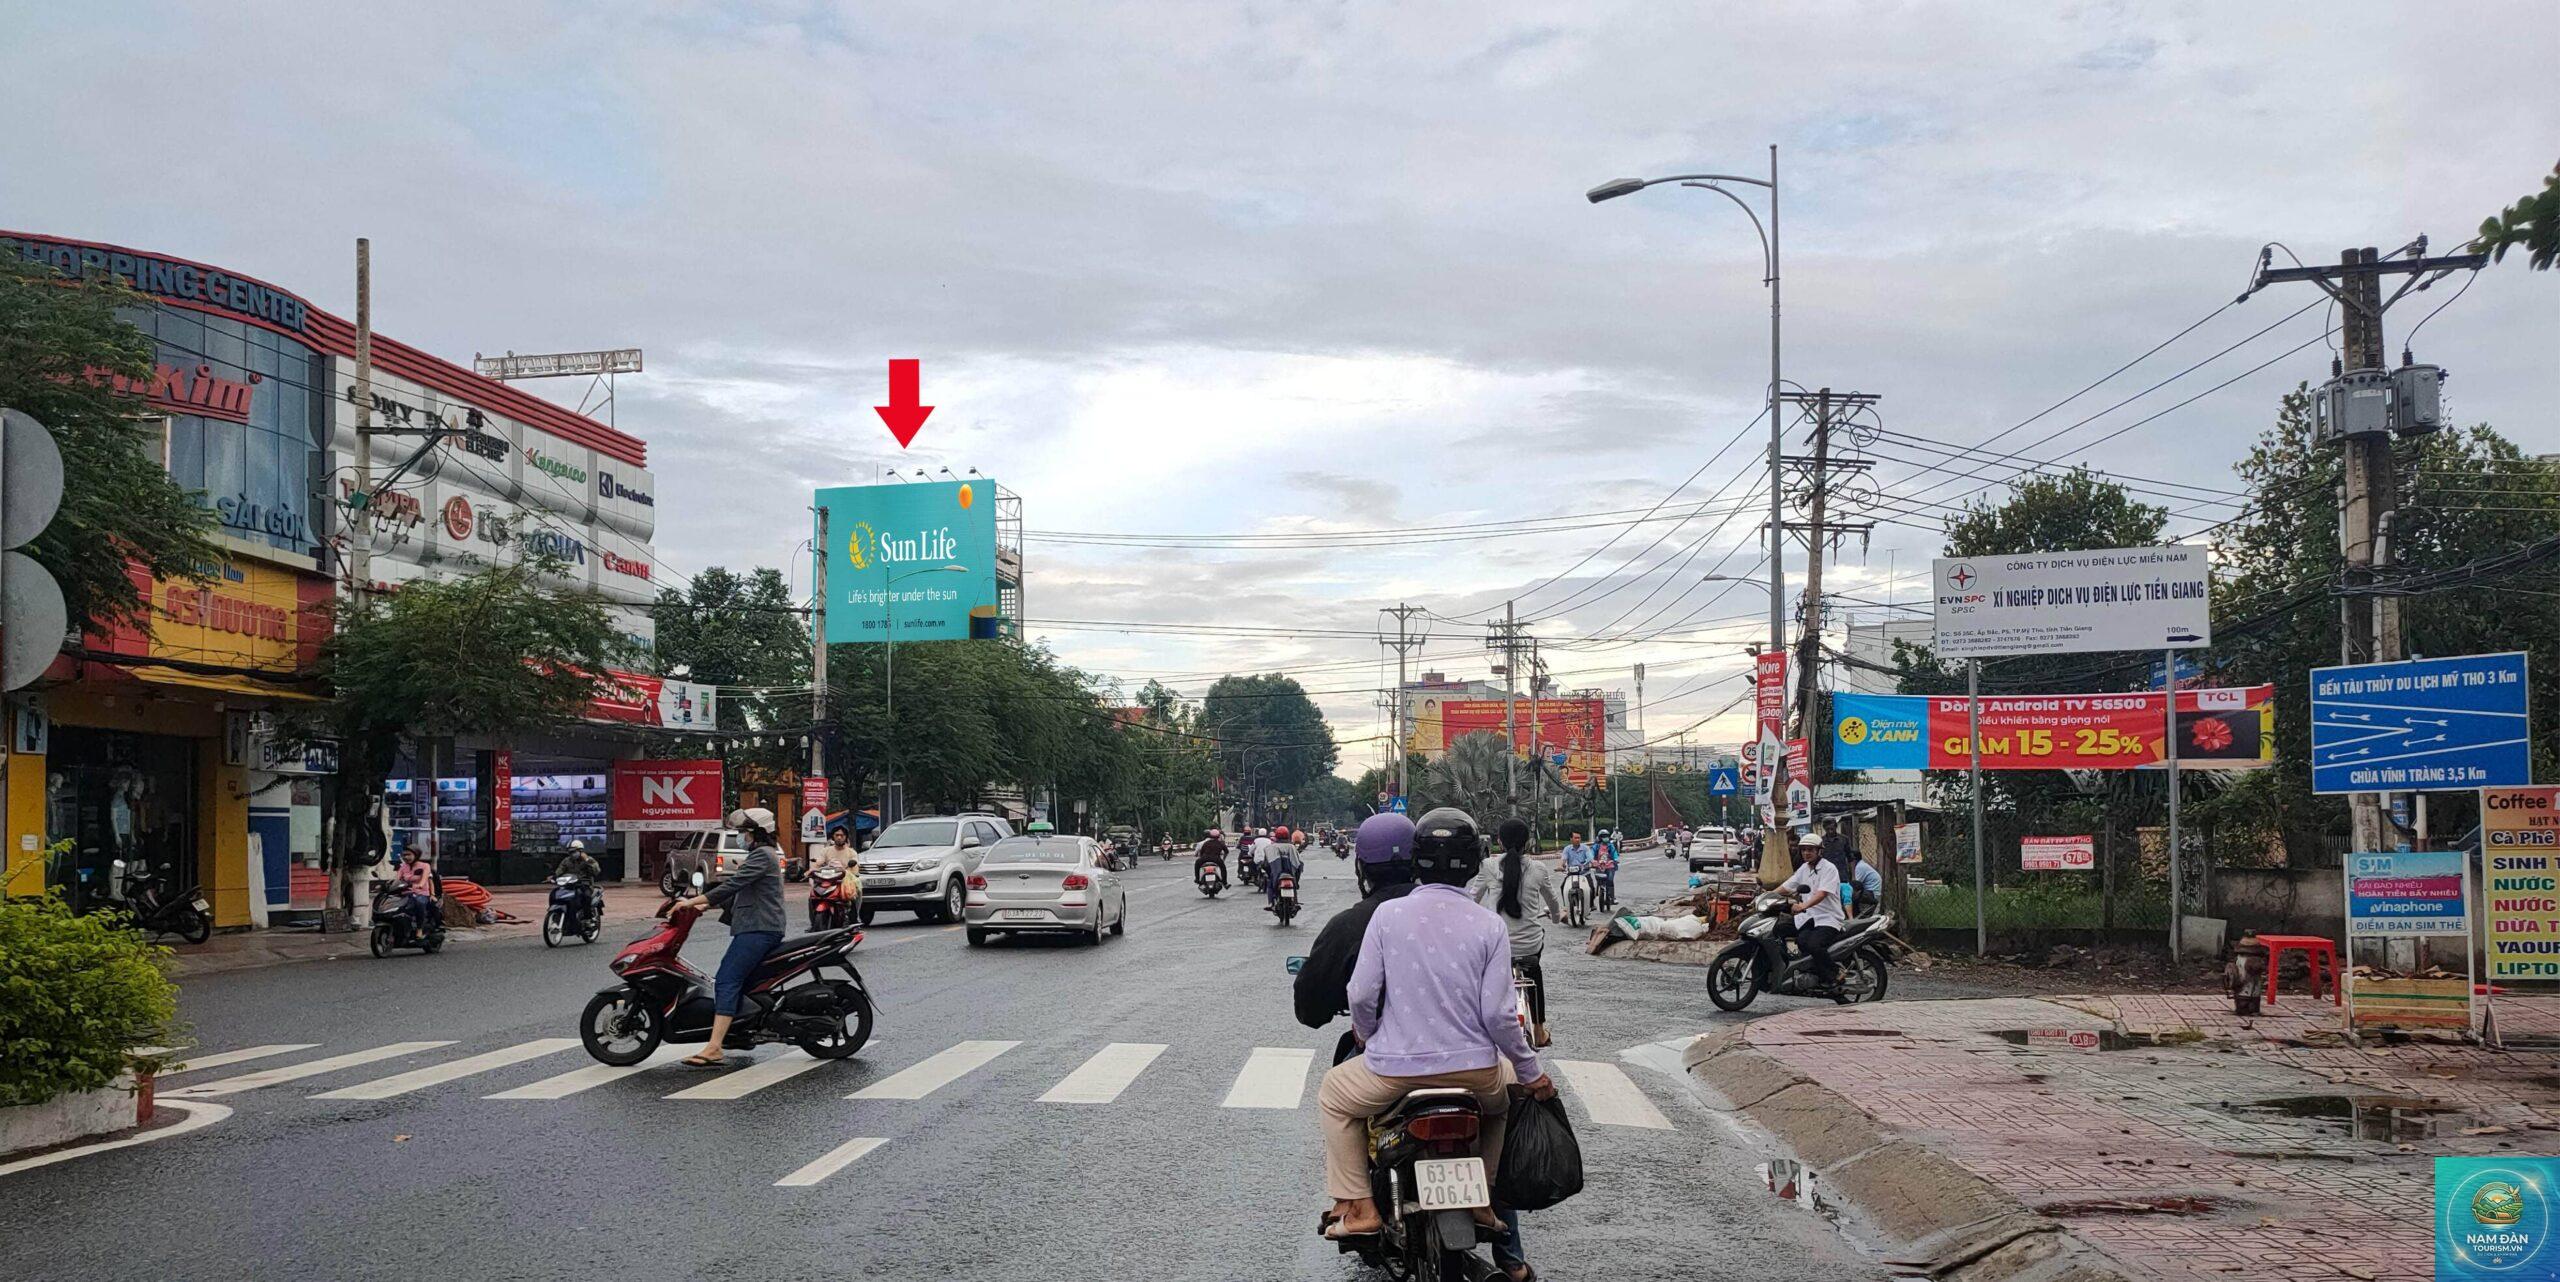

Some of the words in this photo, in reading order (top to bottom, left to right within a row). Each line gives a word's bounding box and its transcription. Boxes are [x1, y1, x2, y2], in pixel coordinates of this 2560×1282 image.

[205, 271, 307, 332] CENTER
[616, 483, 654, 507] Electrolux
[217, 492, 261, 529] SÀI
[265, 502, 305, 541] GÒN
[880, 532, 916, 562] Sun
[920, 527, 957, 560] Life
[2006, 560, 2034, 571] CÔNG
[2037, 560, 2048, 569] TY
[2051, 559, 2074, 570] DỊCH
[2077, 559, 2089, 568] VỤ
[2092, 556, 2115, 567] ĐIỆN
[2118, 556, 2137, 566] LỰC
[2166, 554, 2188, 562] NAM
[848, 589, 867, 603] Life's
[902, 588, 925, 601] under
[927, 588, 940, 600] the
[943, 589, 957, 600] sun
[1993, 584, 2004, 608] XÍ
[2006, 585, 2044, 610] NGHIỆP
[2047, 587, 2072, 608] DỊCH
[2075, 586, 2089, 608] VỤ
[2093, 581, 2118, 606] ĐIỆN
[2121, 581, 2141, 605] LỰC
[2172, 580, 2204, 599] GIANG
[1951, 606, 1975, 614] SPSC
[862, 621, 875, 629] 1800
[904, 619, 945, 628] sunlife.com.vn
[2167, 626, 2189, 634] 100m
[2319, 678, 2341, 696] BẾN
[2342, 678, 2363, 694] TÀU
[2365, 674, 2393, 692] THỦY
[2396, 677, 2411, 690] DU
[2414, 675, 2439, 692] LỊCH
[2442, 670, 2458, 687] MỸ
[2462, 672, 2485, 686] THO
[2487, 671, 2495, 684] 3
[2498, 670, 2517, 683] Km
[2205, 692, 2238, 702] TCL
[1989, 700, 2059, 712] Android
[2064, 699, 2090, 711] TV
[2092, 698, 2147, 710] S6500
[2000, 715, 2028, 725] khiển
[2032, 715, 2057, 726] bằng
[2094, 715, 2110, 724] nói
[1869, 729, 1919, 742] XANH
[1944, 731, 2010, 755] GIẢM
[2016, 728, 2053, 755] 15
[2075, 728, 2143, 755] 25%
[2350, 767, 2379, 784] CHÙA
[2381, 766, 2406, 782] VĨNH
[2408, 765, 2445, 781] TRÀNG
[2447, 767, 2466, 783] 3,5
[2468, 767, 2487, 780] Km
[643, 776, 695, 805] NK
[2487, 793, 2548, 810] Coffee
[2529, 816, 2549, 827] HẠT
[2490, 831, 2514, 845] Cà
[2518, 831, 2554, 845] Phê
[2493, 857, 2547, 869] SINH
[2494, 876, 2555, 891] NƯỚC
[2374, 901, 2444, 913] vinaphone
[2495, 897, 2556, 912] NƯỚC
[2415, 921, 2436, 930] SIM
[2496, 918, 2540, 933] DỪA
[1426, 1162, 1473, 1184] 63-C1
[1423, 1185, 1483, 1206] 206.41
